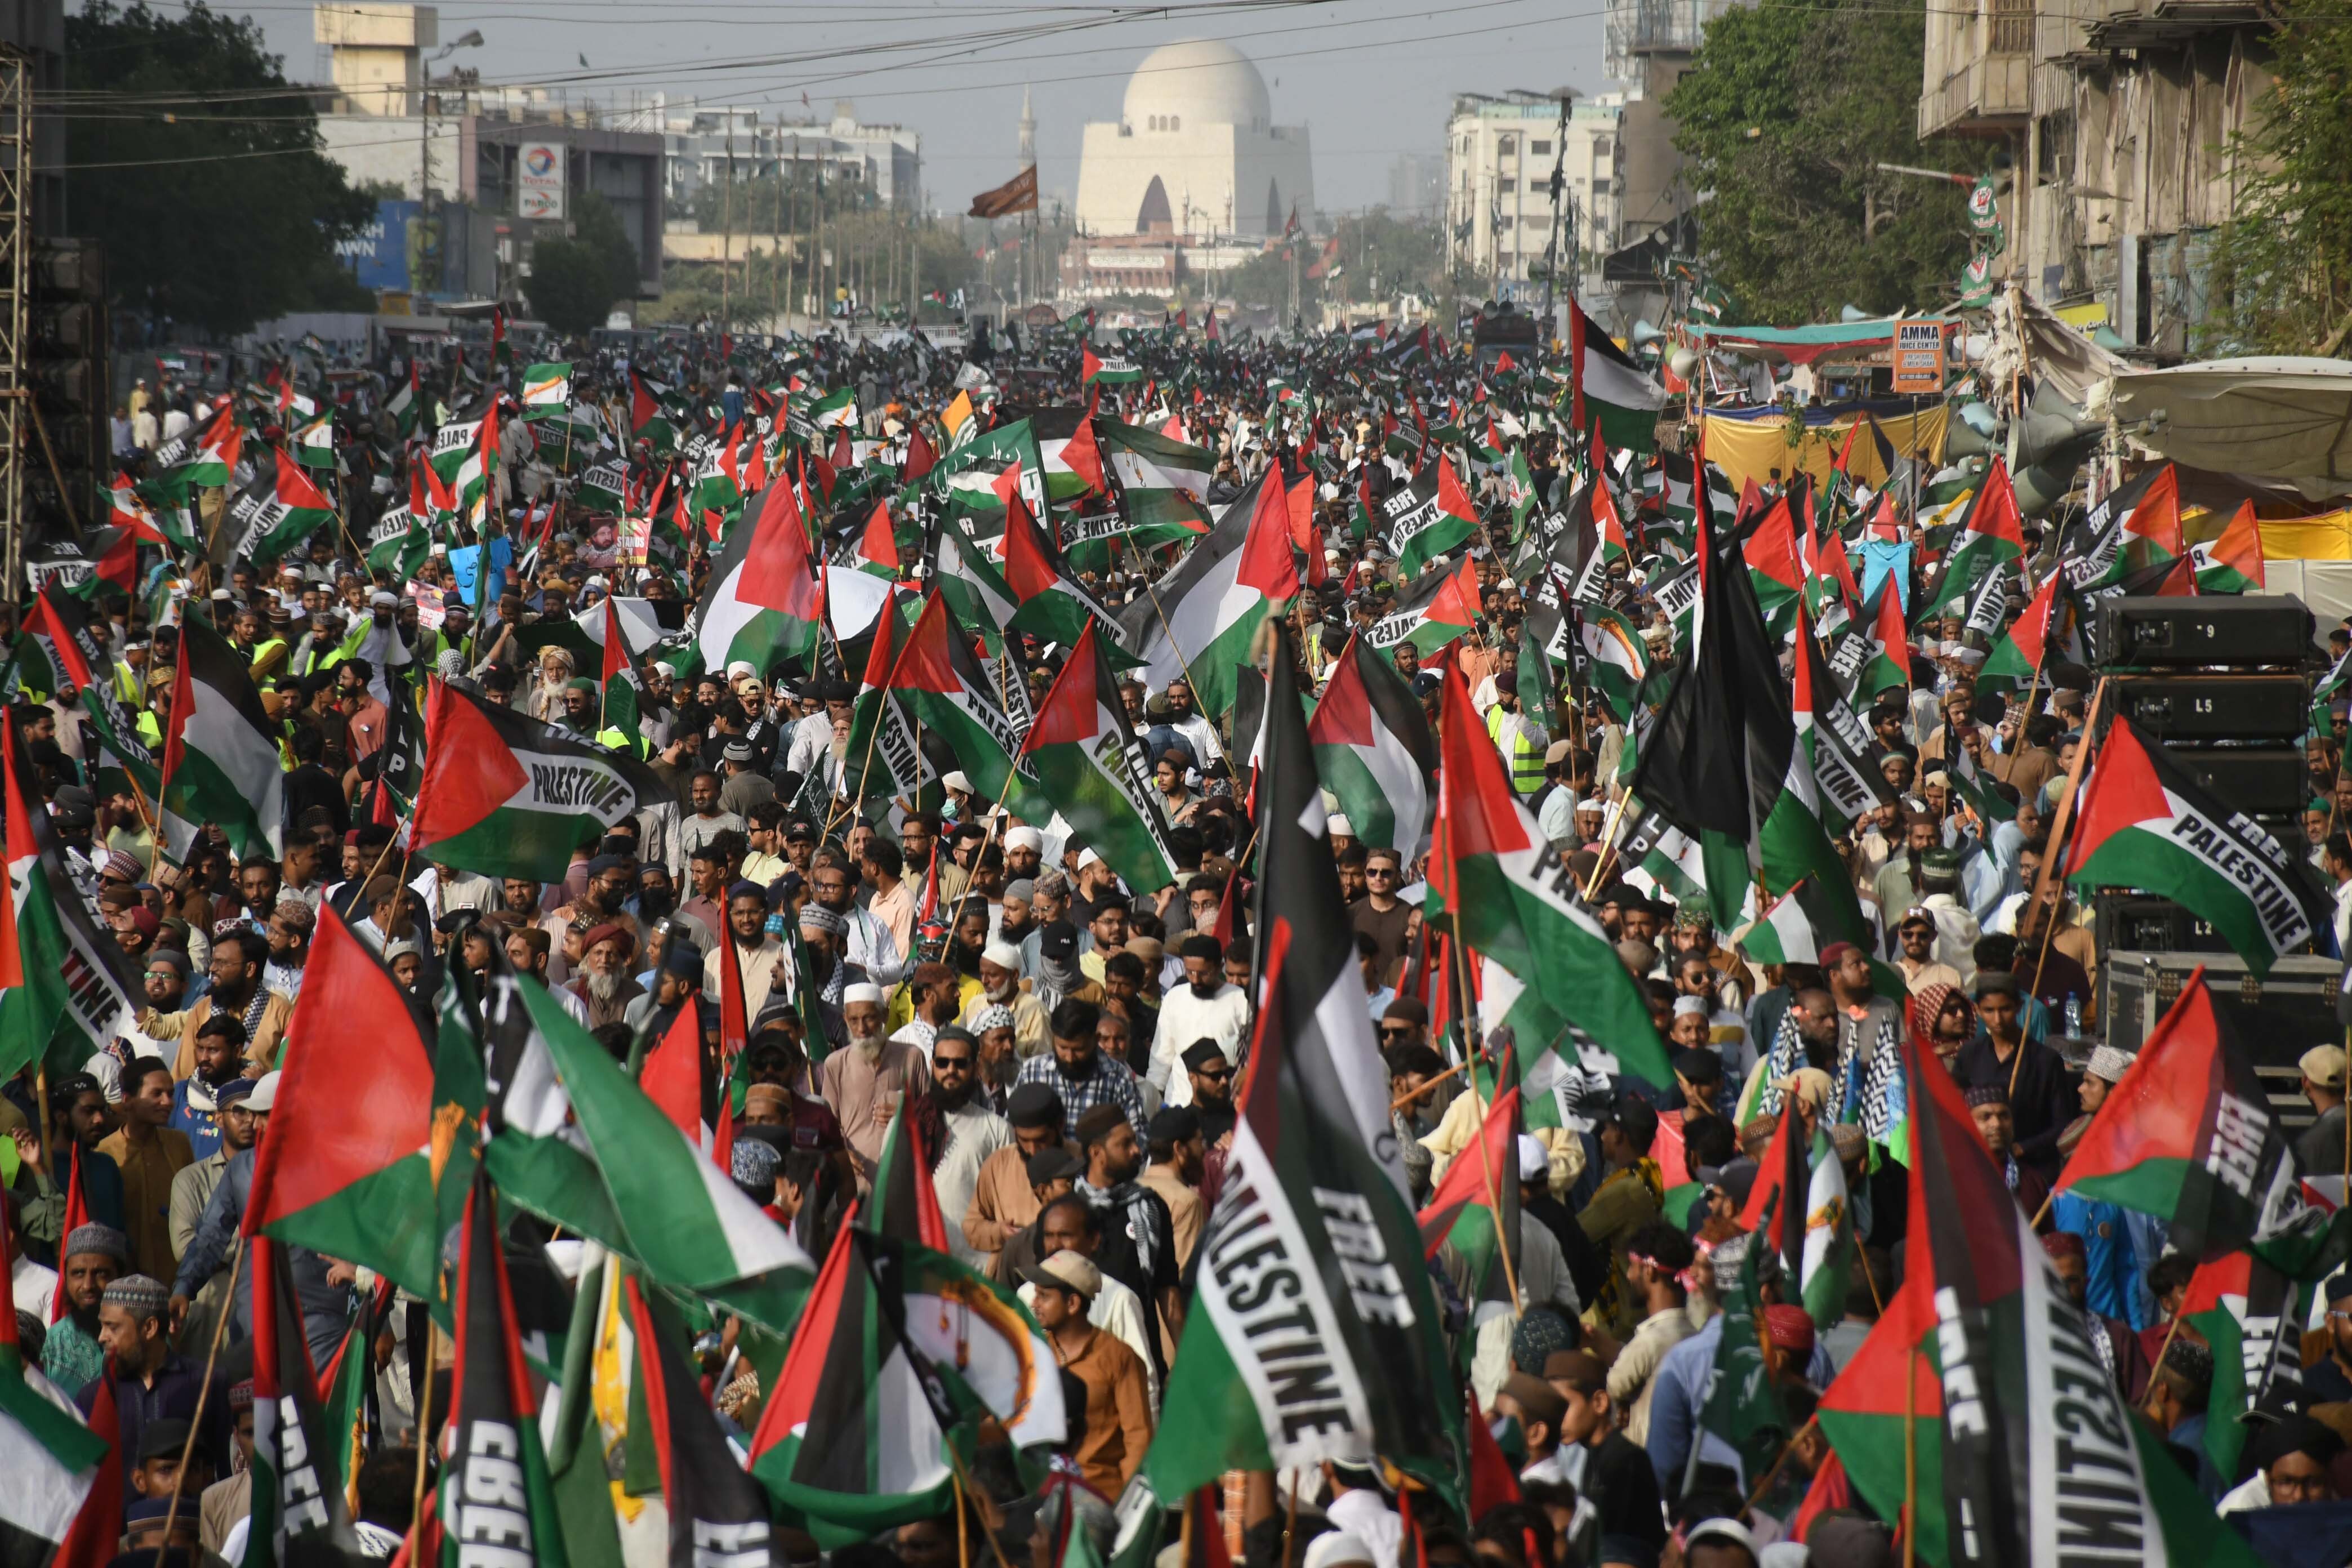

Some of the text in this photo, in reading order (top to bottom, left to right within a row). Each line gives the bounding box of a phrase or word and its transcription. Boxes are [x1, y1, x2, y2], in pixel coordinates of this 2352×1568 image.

[1900, 327, 1939, 340] AMMA
[1826, 697, 1870, 758] FREE
[531, 763, 632, 819] PALESTINE
[2228, 812, 2289, 869] FREE
[2172, 813, 2308, 947] PALESTINE
[1311, 1186, 1415, 1329] FREE
